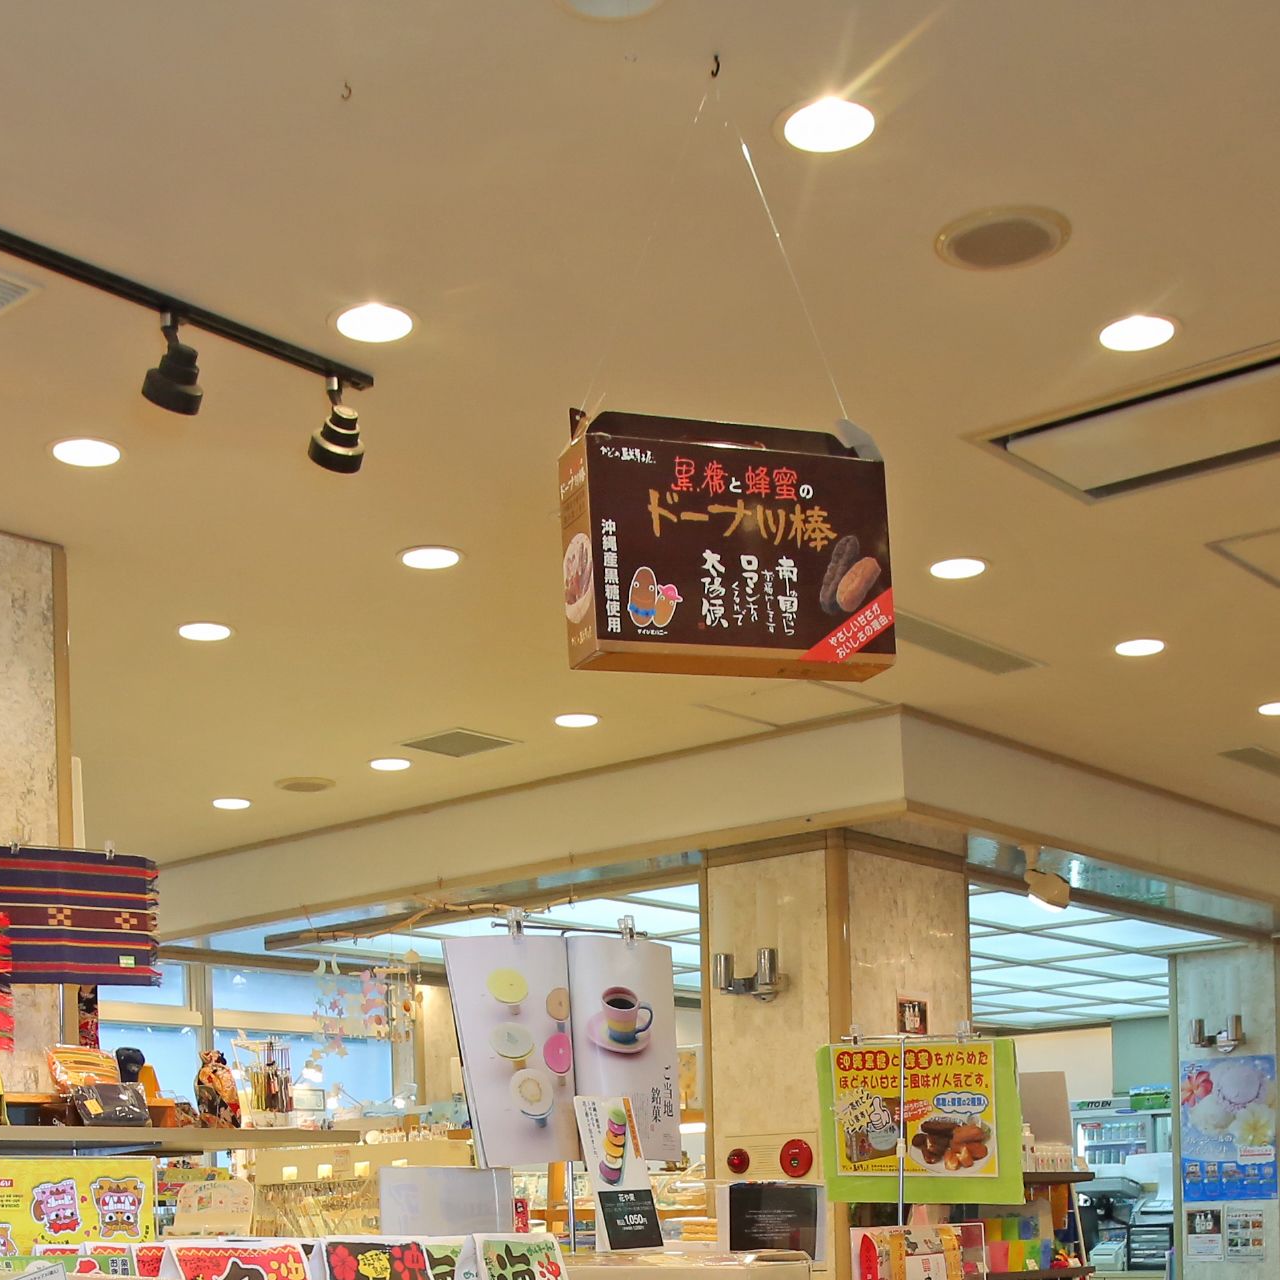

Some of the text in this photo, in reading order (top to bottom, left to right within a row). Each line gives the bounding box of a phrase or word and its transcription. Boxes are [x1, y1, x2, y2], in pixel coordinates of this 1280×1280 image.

[600, 518, 622, 634] 沖縄産黒糖使用
[650, 1087, 662, 1124] 銘菓
[663, 1064, 675, 1118] ご当地
